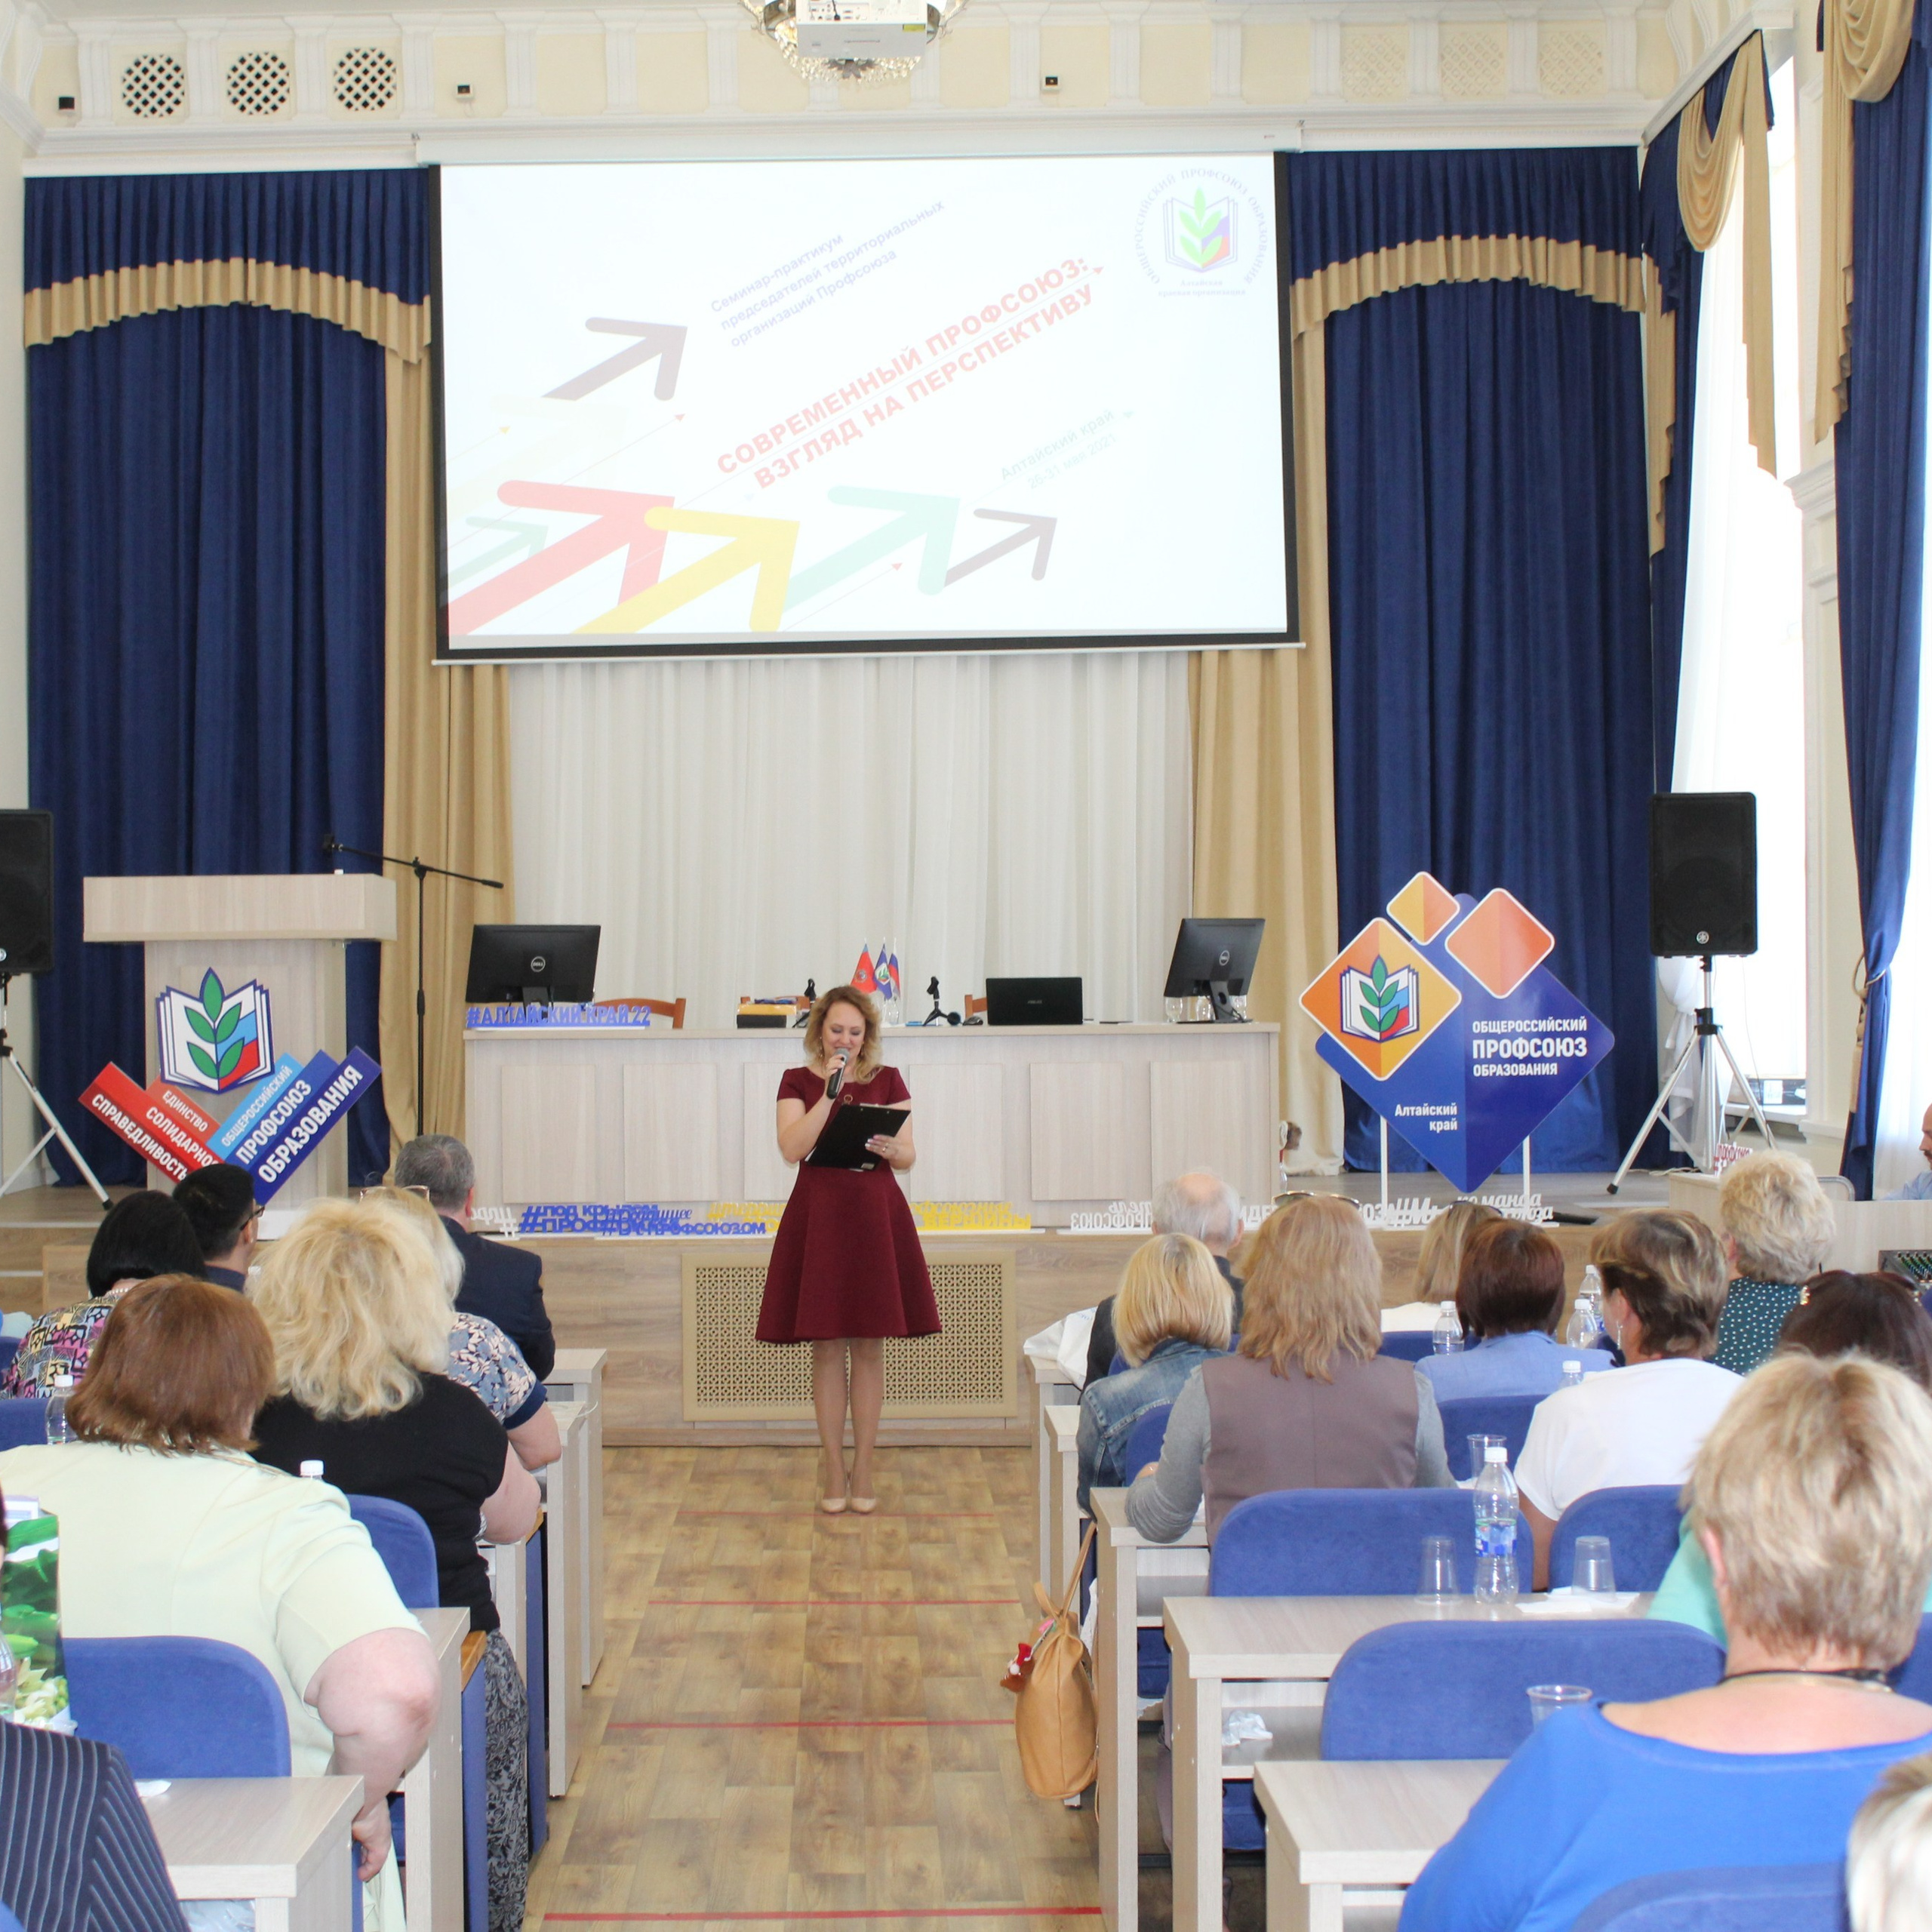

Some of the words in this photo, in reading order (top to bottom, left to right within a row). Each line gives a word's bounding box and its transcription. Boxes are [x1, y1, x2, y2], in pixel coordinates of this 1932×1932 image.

[721, 265, 823, 331] председателей
[823, 199, 946, 282] территориальных
[1180, 168, 1247, 195] ПРОФСОЮЗ
[1243, 196, 1268, 285] ОБРАЗОВАНИЯ
[710, 233, 844, 313] Семинар-практикум
[731, 291, 817, 348] организаций
[817, 249, 898, 300] Профсоюза
[717, 346, 924, 475] СОВРЕМЕННЫЙ
[925, 255, 1090, 358] ПРОФСОЮЗ:
[753, 420, 863, 489] ВЗГЛЯД
[863, 395, 906, 428] НА
[906, 284, 1094, 404] ПЕРСПЕКТИВУ
[1001, 429, 1078, 481] Алтайский
[1079, 409, 1115, 435] край
[1472, 1016, 1587, 1034] ОБЩЕРОССИЙСКИЙ
[1472, 1037, 1587, 1059] ПРОФСОЮЗ
[220, 1065, 294, 1148] ОБЩЕРОССИЙСКИЙ
[1395, 1103, 1457, 1117] Алтайский
[1472, 1063, 1558, 1077] ОБРАЗОВАНИЯ
[91, 1094, 188, 1182] СПРАВЕДЛИВОСТЬ
[145, 1106, 220, 1168] СОЛИДАРНО
[162, 1090, 209, 1133] ЕДИНСТВО
[235, 1079, 312, 1164] ПРОФСОЮЗ
[257, 1064, 364, 1183] ОБРАЗОВАНИЯ
[1429, 1119, 1457, 1133] край
